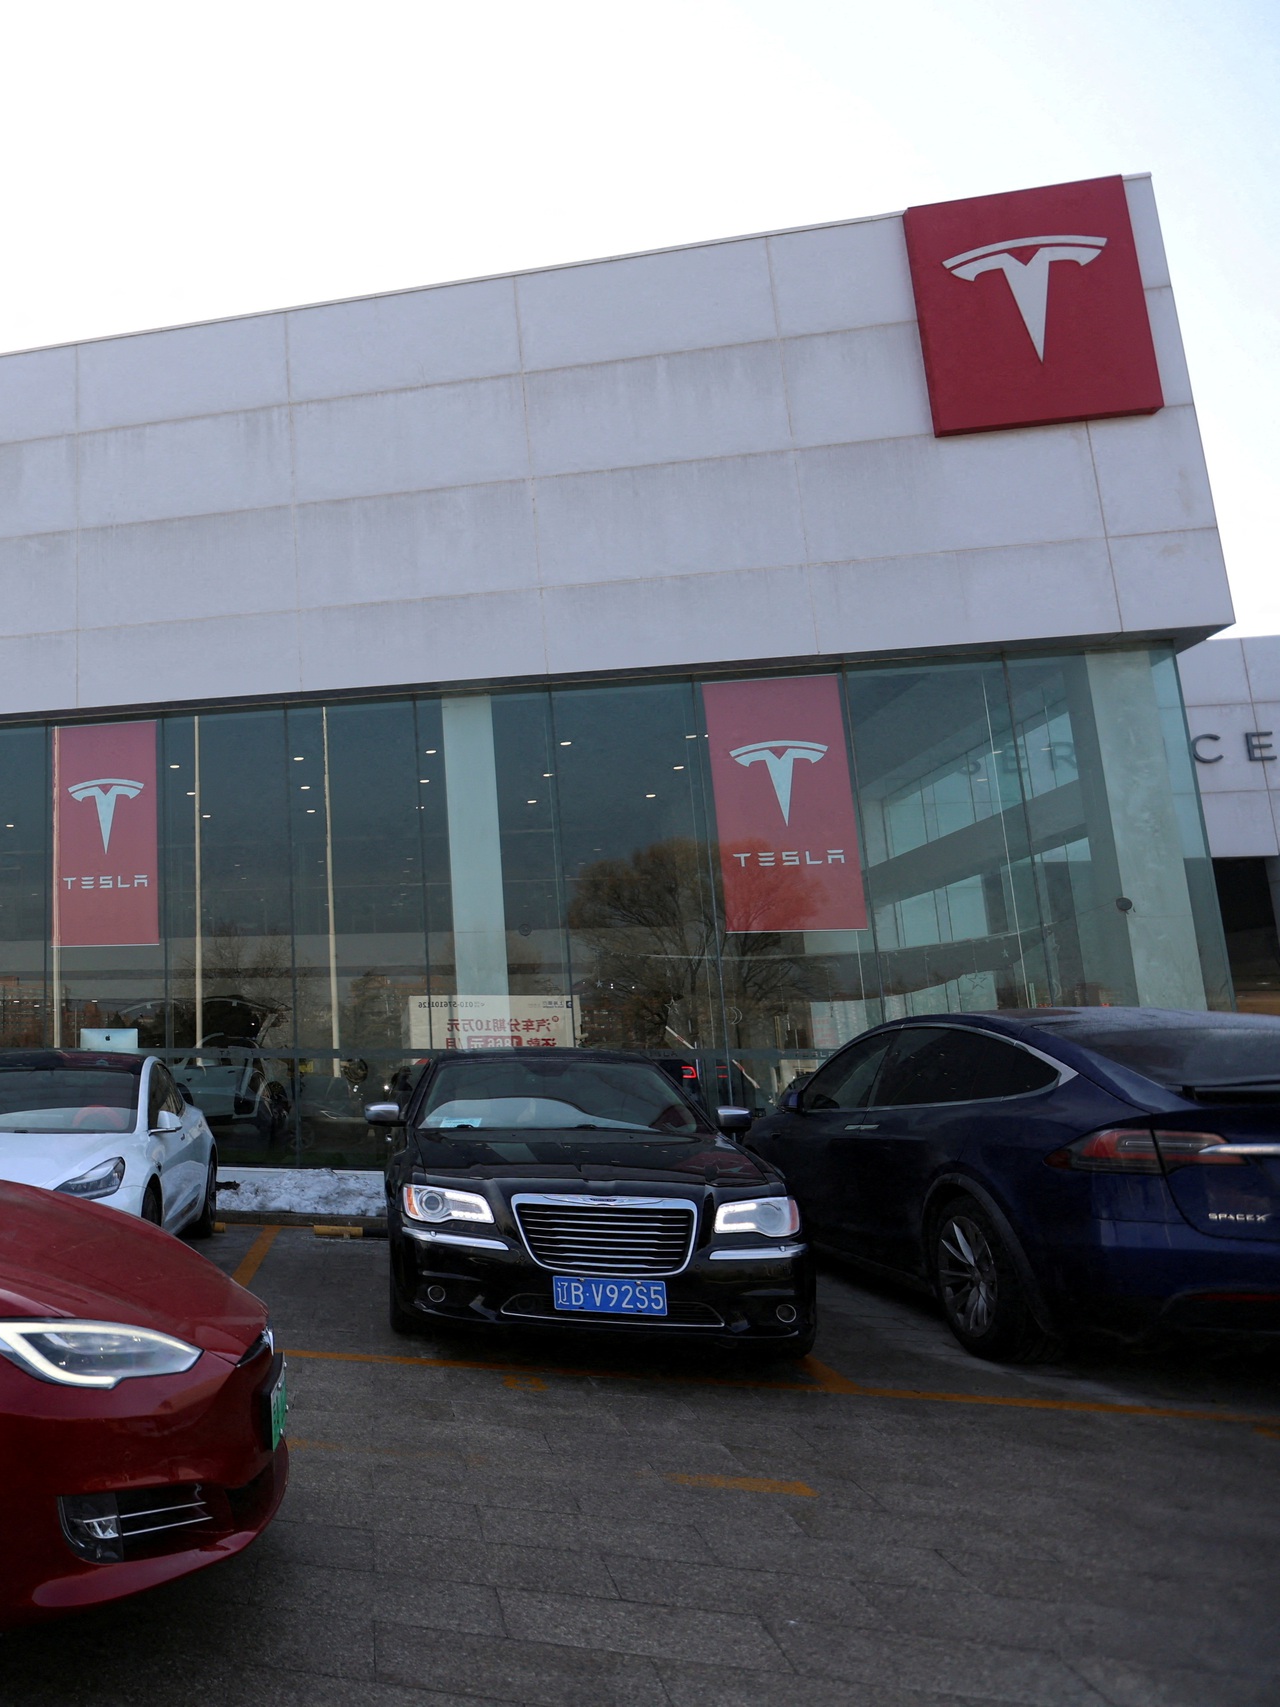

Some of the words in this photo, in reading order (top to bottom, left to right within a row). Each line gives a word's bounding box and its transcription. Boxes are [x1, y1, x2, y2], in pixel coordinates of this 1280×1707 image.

[732, 849, 845, 867] TESLA
[62, 874, 148, 890] TESLA
[1208, 1213, 1272, 1222] SPACEX
